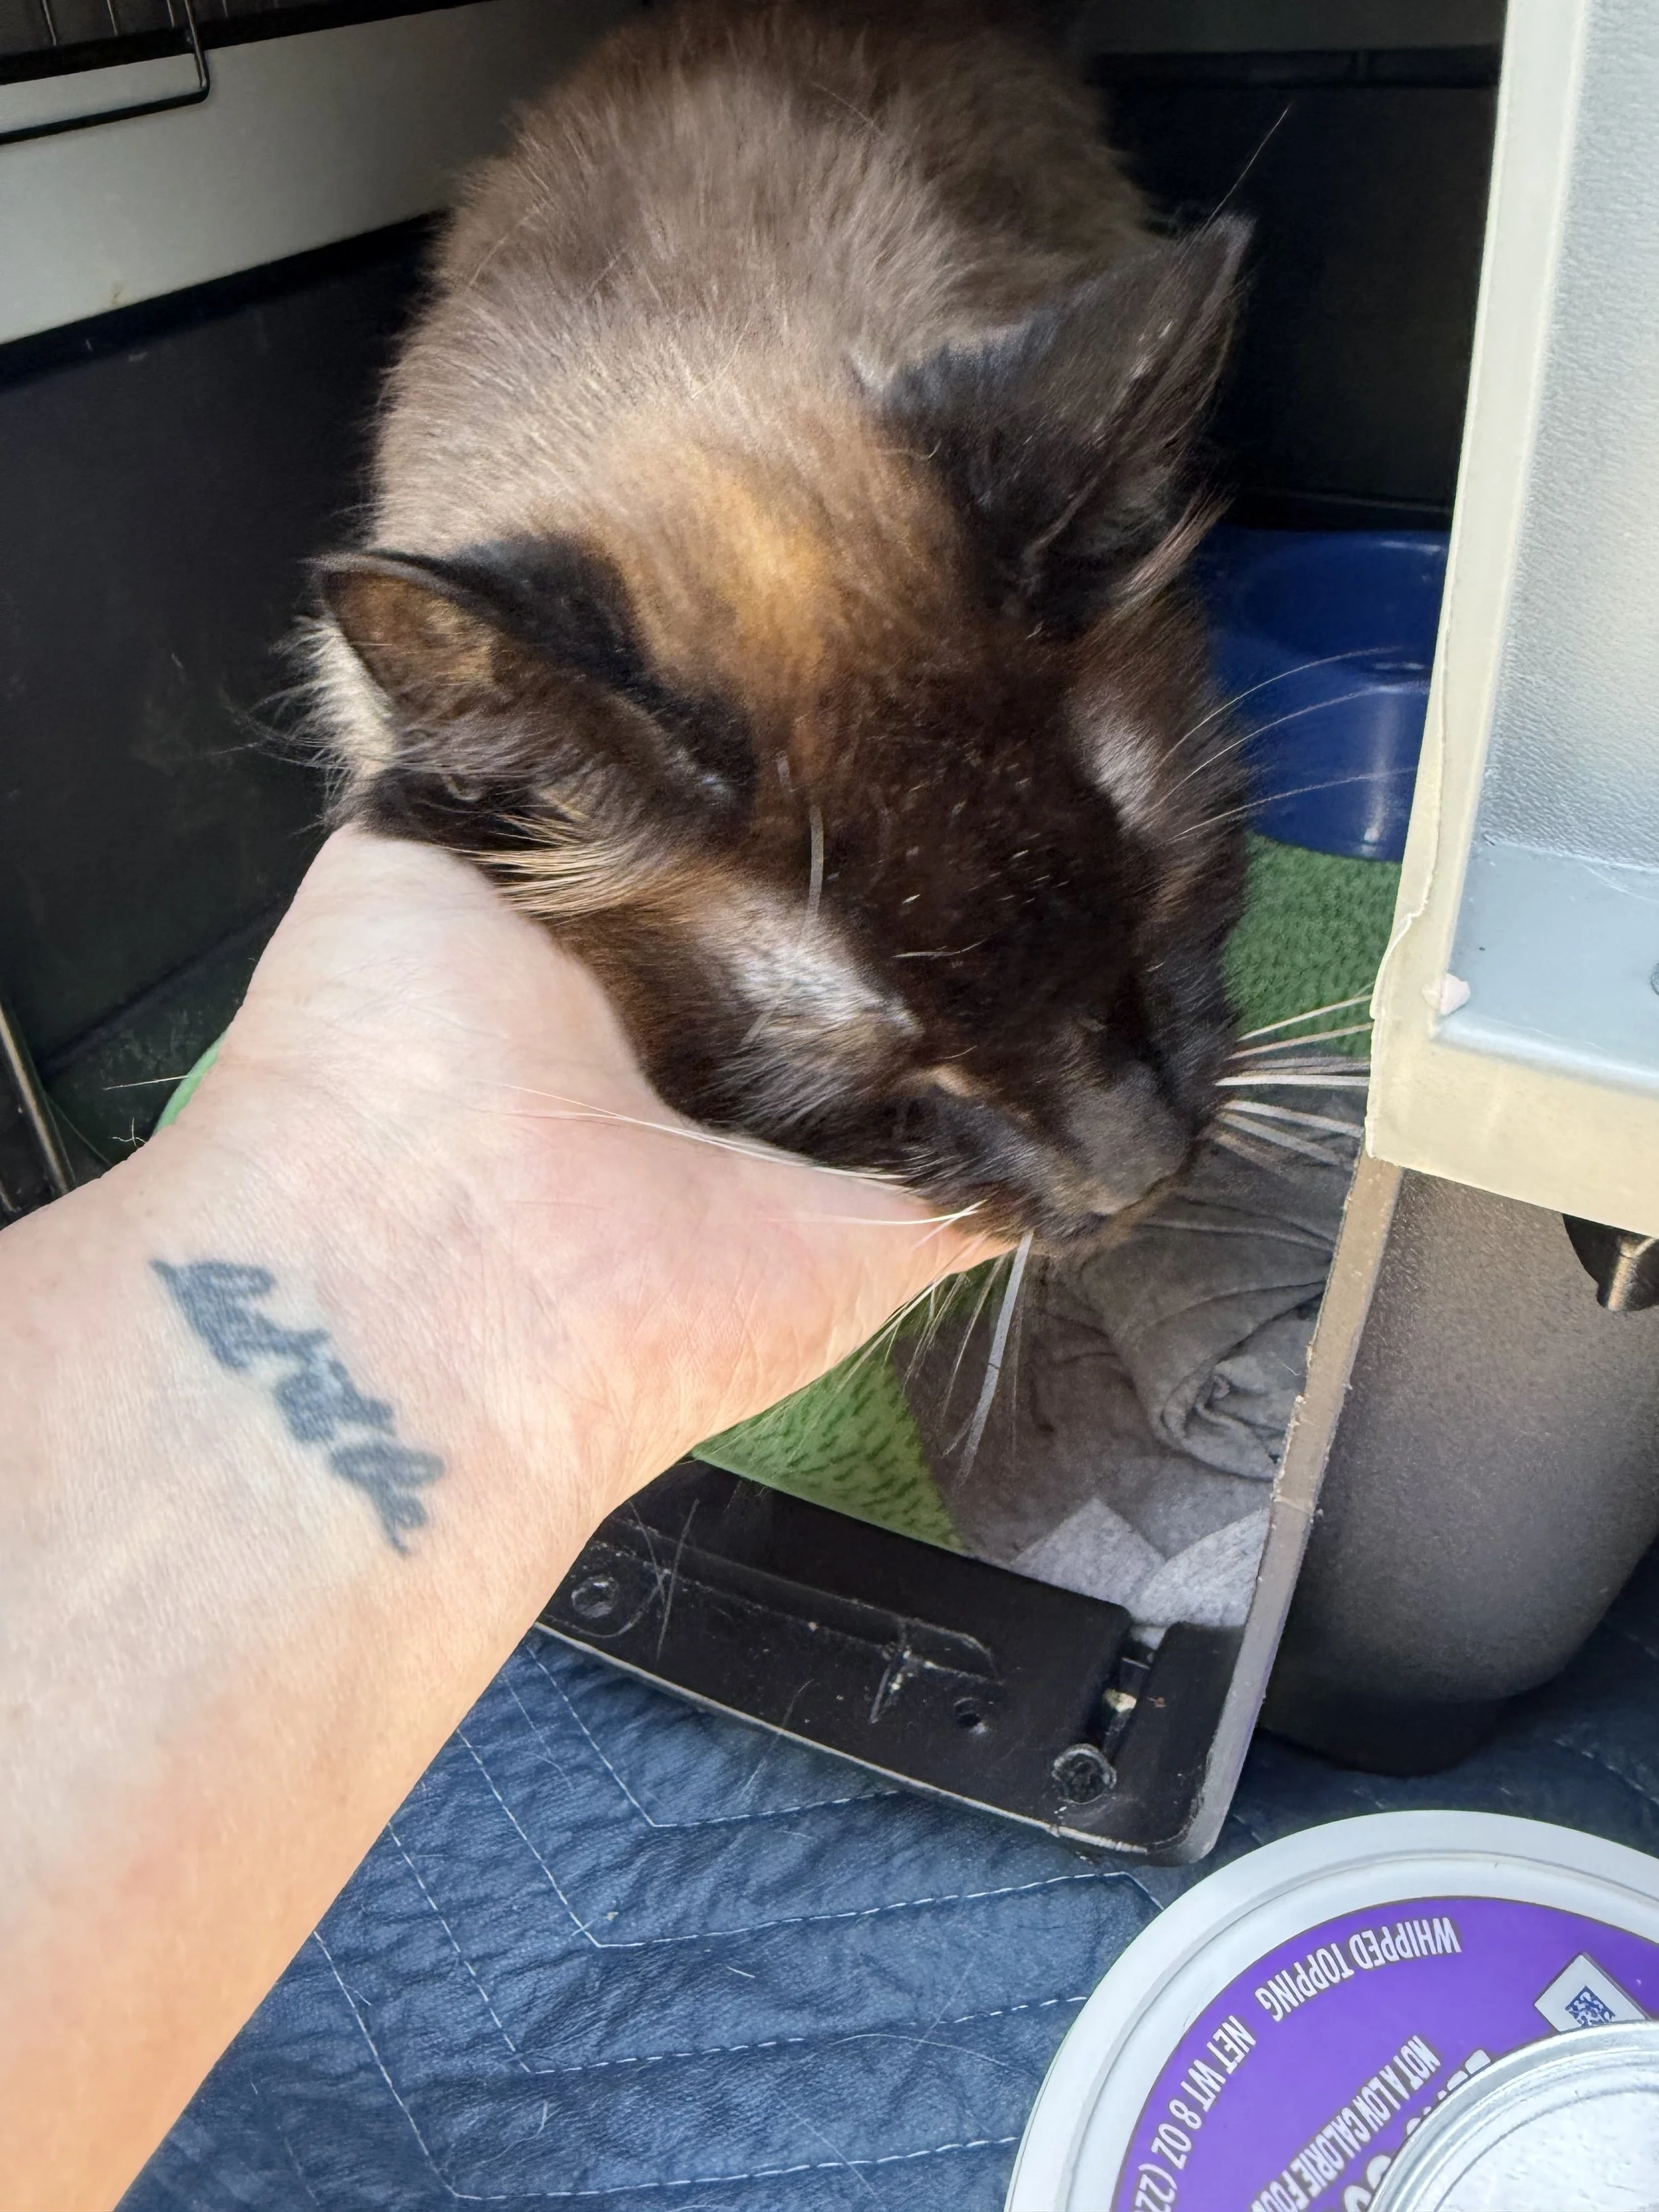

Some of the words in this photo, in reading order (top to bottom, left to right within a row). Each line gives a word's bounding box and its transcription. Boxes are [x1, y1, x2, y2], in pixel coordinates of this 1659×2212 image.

[1349, 1917, 1461, 1970] WHIPPED
[1255, 1943, 1354, 2022] TOPPING
[1206, 2015, 1256, 2075] NET
[1393, 2035, 1441, 2090] NOT
[1181, 2059, 1226, 2112] WT
[1352, 2077, 1401, 2132] LOW
[1379, 2065, 1410, 2101] A
[1169, 2099, 1202, 2130] 8
[1151, 2123, 1192, 2170] OZ
[1289, 2107, 1371, 2198] CALORIE
[1131, 2164, 1177, 2212] (22
